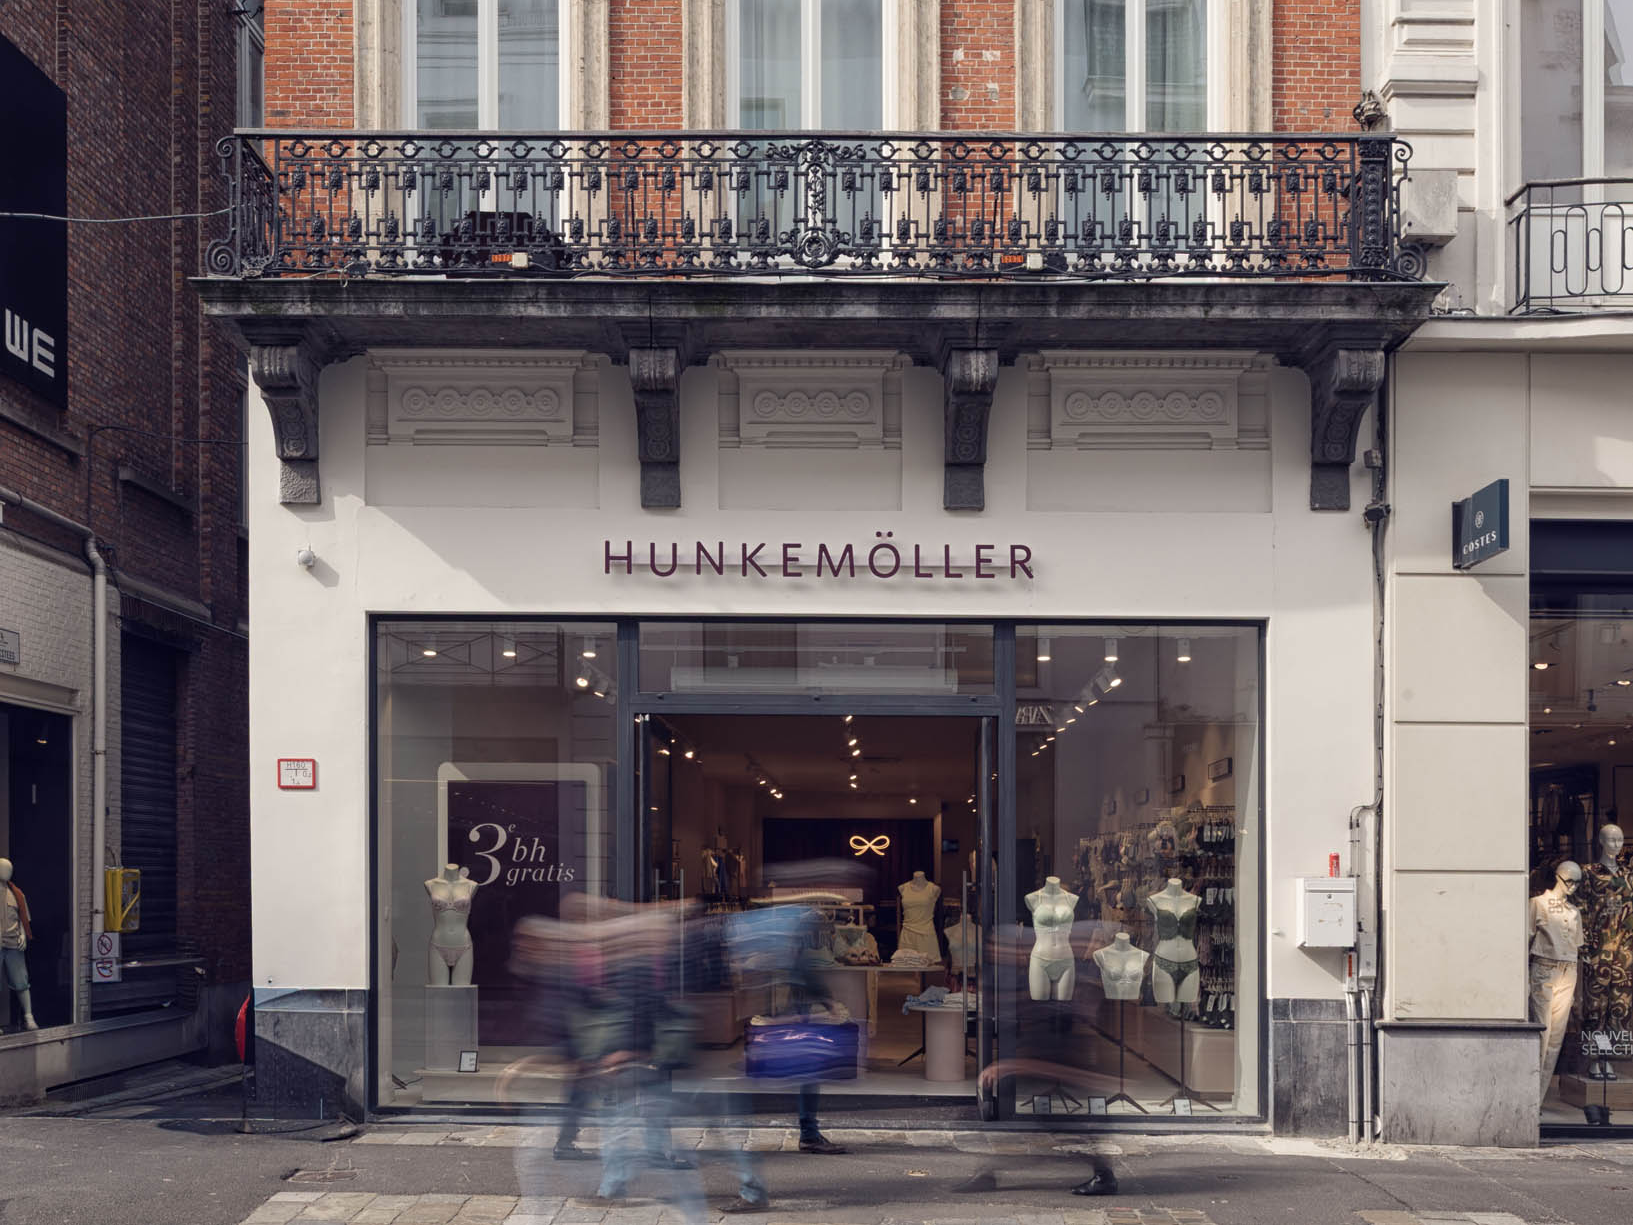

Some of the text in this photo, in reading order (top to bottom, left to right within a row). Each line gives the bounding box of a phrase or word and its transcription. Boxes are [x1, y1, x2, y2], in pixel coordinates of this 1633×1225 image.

[5, 307, 55, 379] WE
[604, 530, 1034, 579] HUNKEMÖLLER
[1463, 530, 1497, 555] COSTES
[511, 837, 546, 863] bh
[506, 862, 575, 887] gratis
